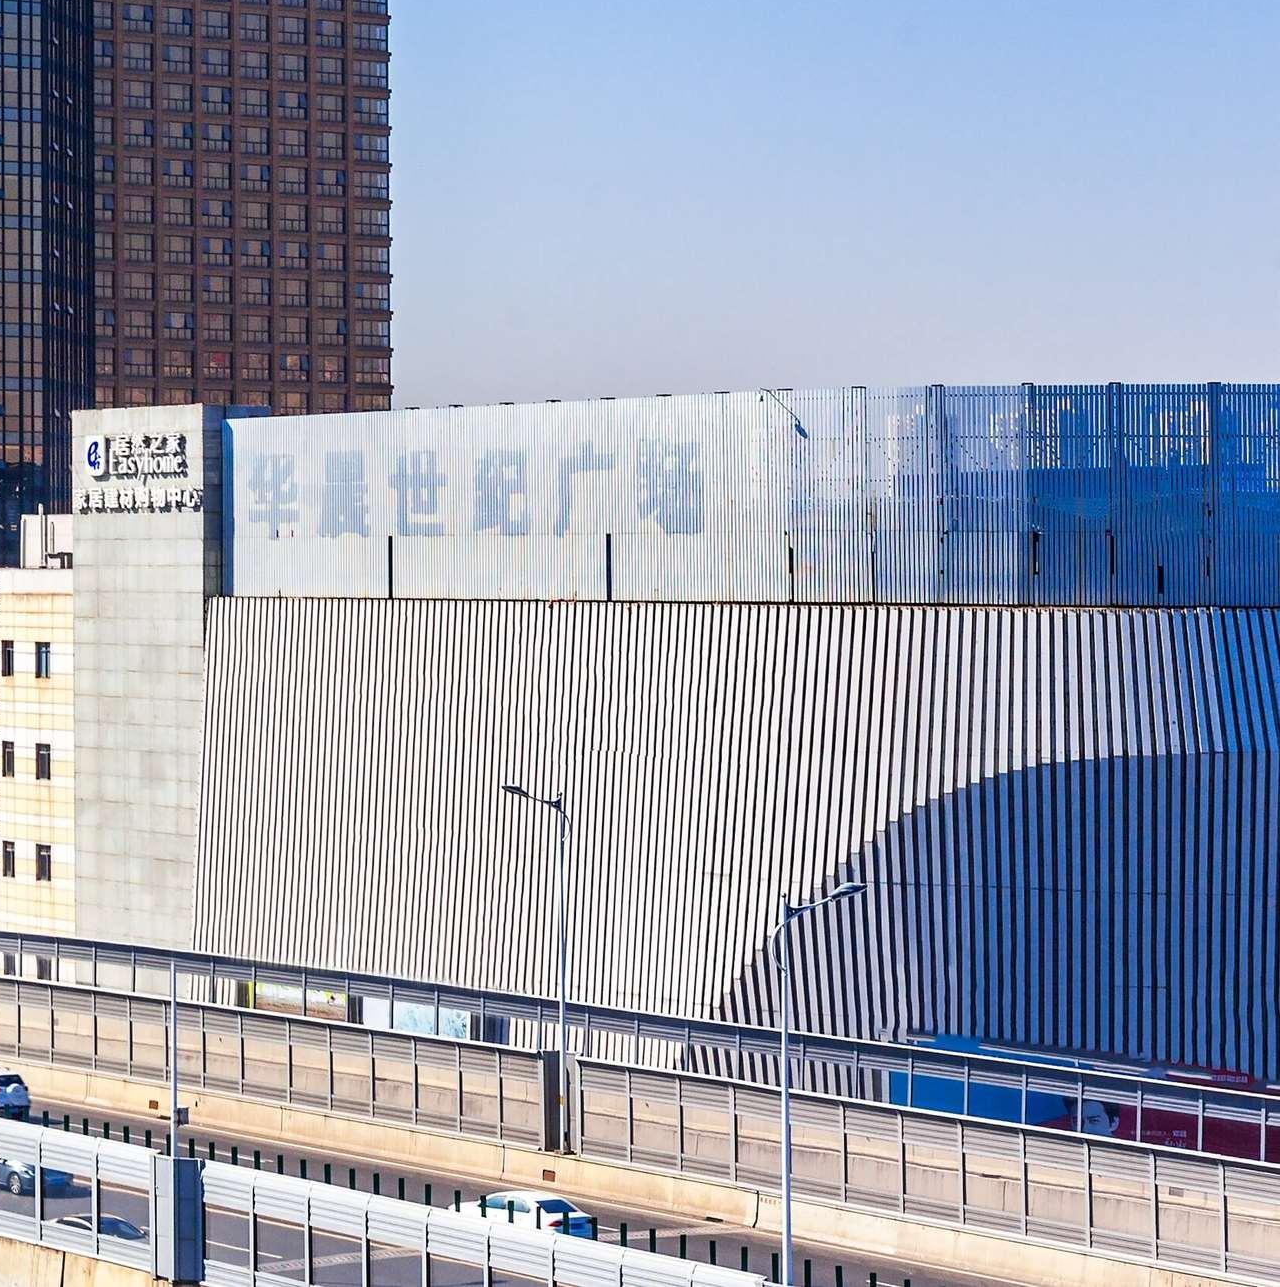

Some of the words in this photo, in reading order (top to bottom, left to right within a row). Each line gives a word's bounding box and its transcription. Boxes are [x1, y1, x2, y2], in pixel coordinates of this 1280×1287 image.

[110, 431, 182, 456] 居然之家
[108, 450, 183, 479] Easyhome
